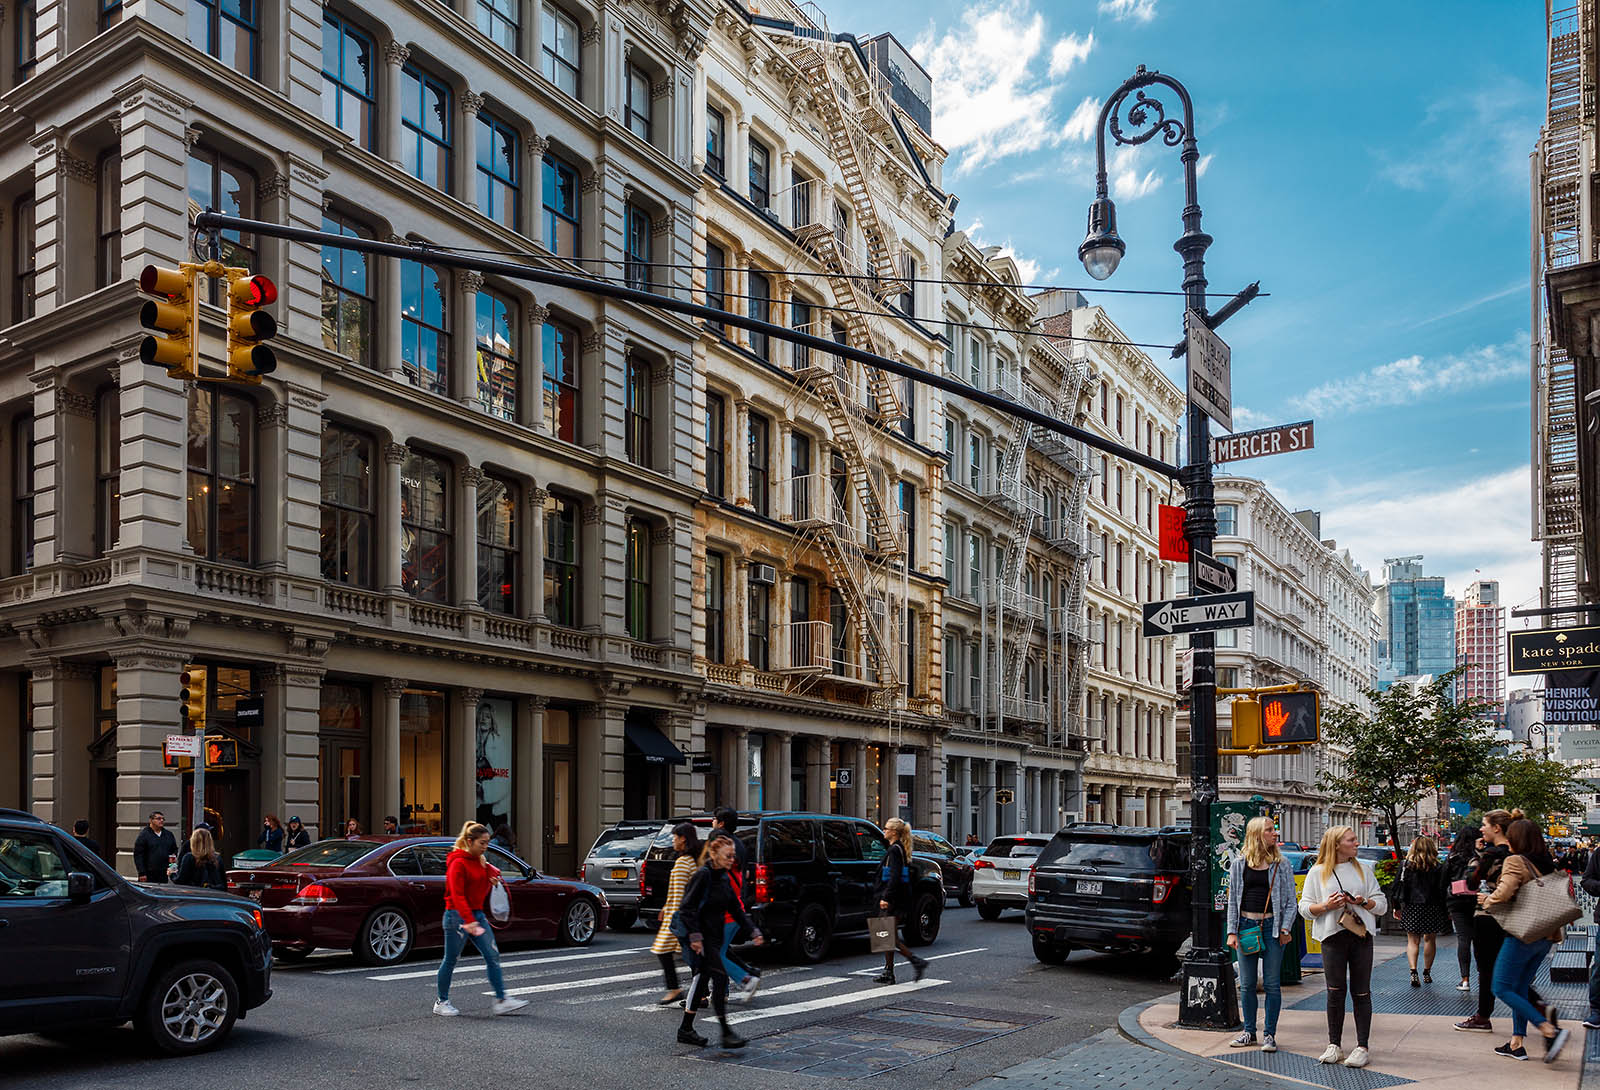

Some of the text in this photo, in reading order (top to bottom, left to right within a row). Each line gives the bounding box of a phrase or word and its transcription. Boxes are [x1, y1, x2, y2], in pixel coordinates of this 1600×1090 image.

[1199, 351, 1211, 372] THE
[1218, 432, 1281, 461] MERCER
[1289, 427, 1308, 449] ST
[1201, 565, 1231, 589] ONE WAY
[1159, 603, 1240, 625] ONE WAY
[1521, 647, 1554, 659] kate
[1545, 687, 1591, 698] HENRIK
[1545, 698, 1598, 710] VIBSKOV
